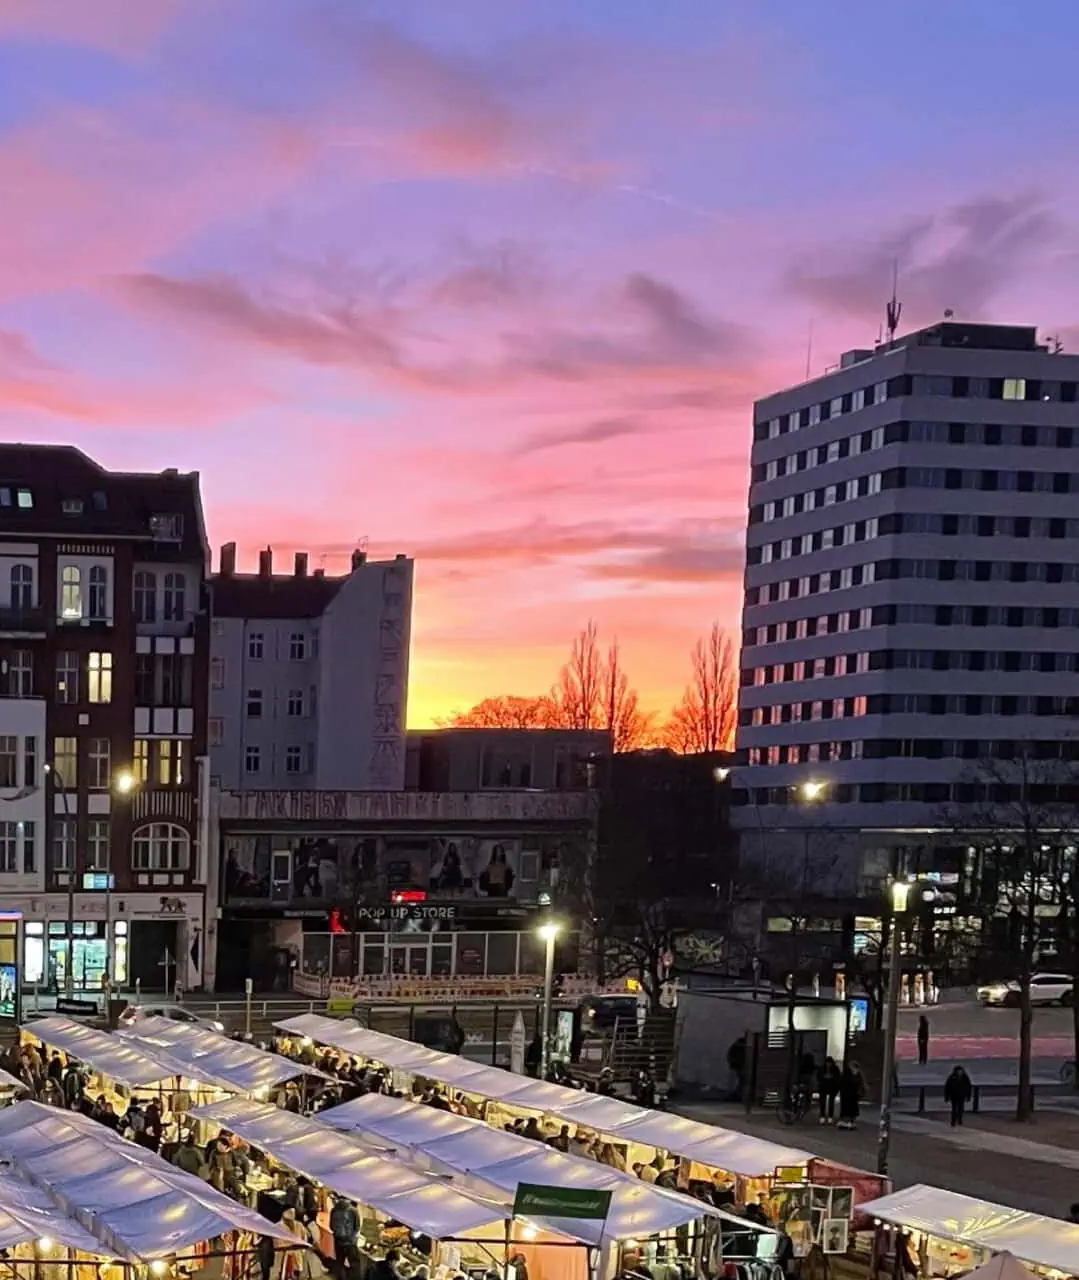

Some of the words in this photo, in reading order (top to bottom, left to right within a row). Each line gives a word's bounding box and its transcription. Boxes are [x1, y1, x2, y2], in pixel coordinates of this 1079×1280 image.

[358, 907, 386, 919] POP
[391, 907, 409, 919] UP
[413, 906, 456, 919] STORE
